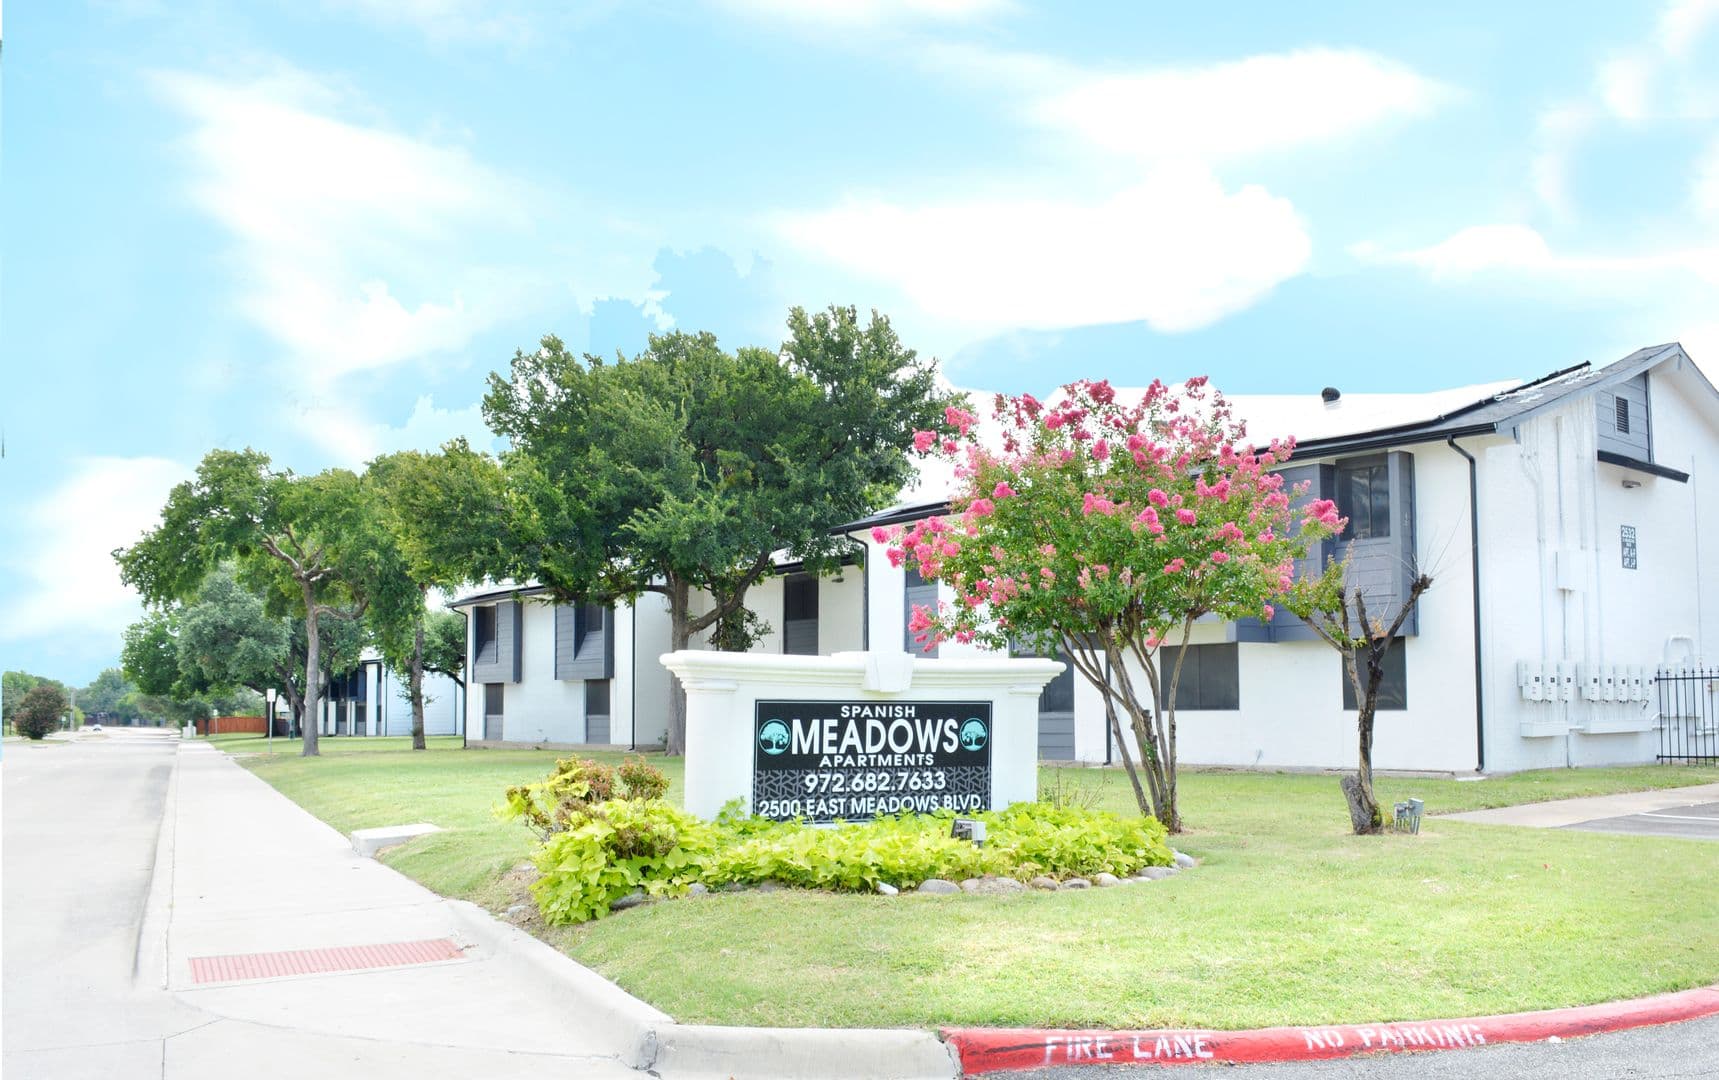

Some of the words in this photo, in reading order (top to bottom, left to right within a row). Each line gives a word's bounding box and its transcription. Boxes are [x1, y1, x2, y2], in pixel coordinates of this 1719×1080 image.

[840, 705, 916, 718] SPANISH
[791, 718, 959, 755] MEADOWS
[819, 754, 934, 768] APARTMENTS
[804, 771, 946, 793] 972.682.7633
[759, 800, 801, 817] 2500
[806, 798, 846, 816] EAST
[851, 795, 939, 815] MEADOWS
[1302, 1029, 1345, 1050] NO
[1356, 1023, 1487, 1047] PARKING
[1045, 1035, 1113, 1063] FIRE
[1132, 1034, 1214, 1059] LANE
